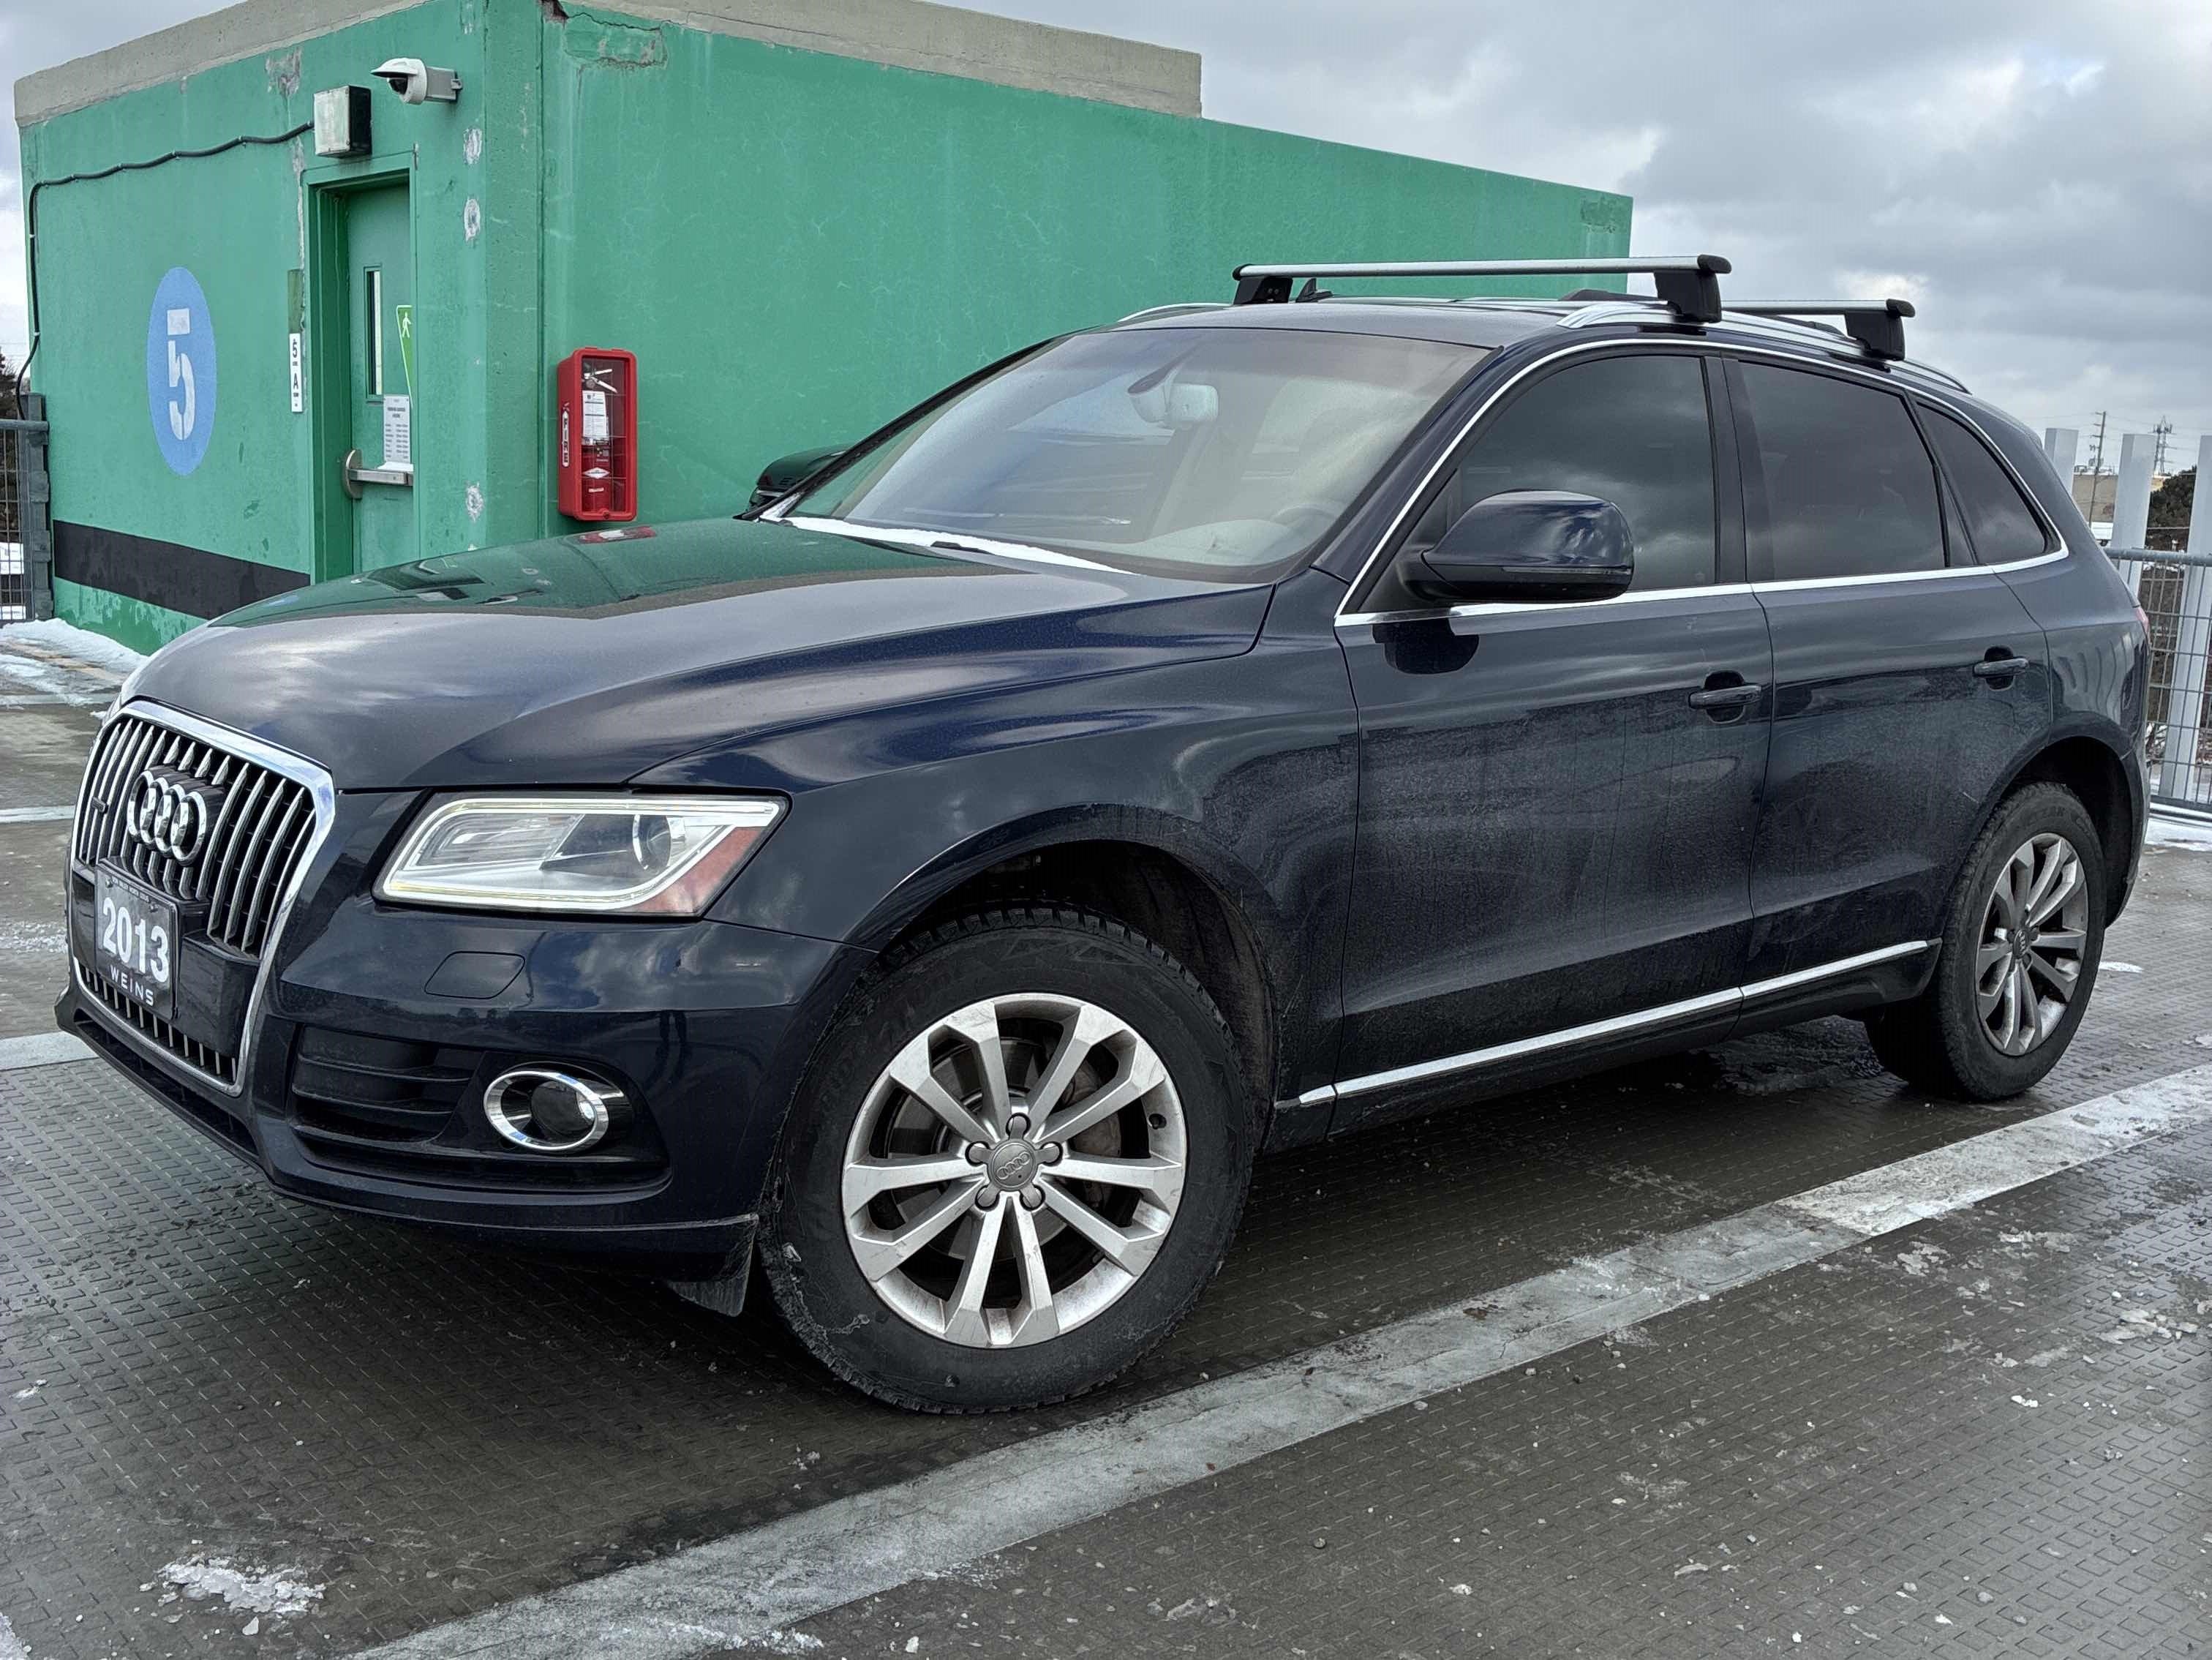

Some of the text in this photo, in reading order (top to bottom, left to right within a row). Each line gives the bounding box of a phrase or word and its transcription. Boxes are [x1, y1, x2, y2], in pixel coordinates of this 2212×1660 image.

[167, 308, 195, 440] 5
[292, 339, 298, 358] 5
[293, 372, 299, 390] A
[102, 897, 170, 983] 2013
